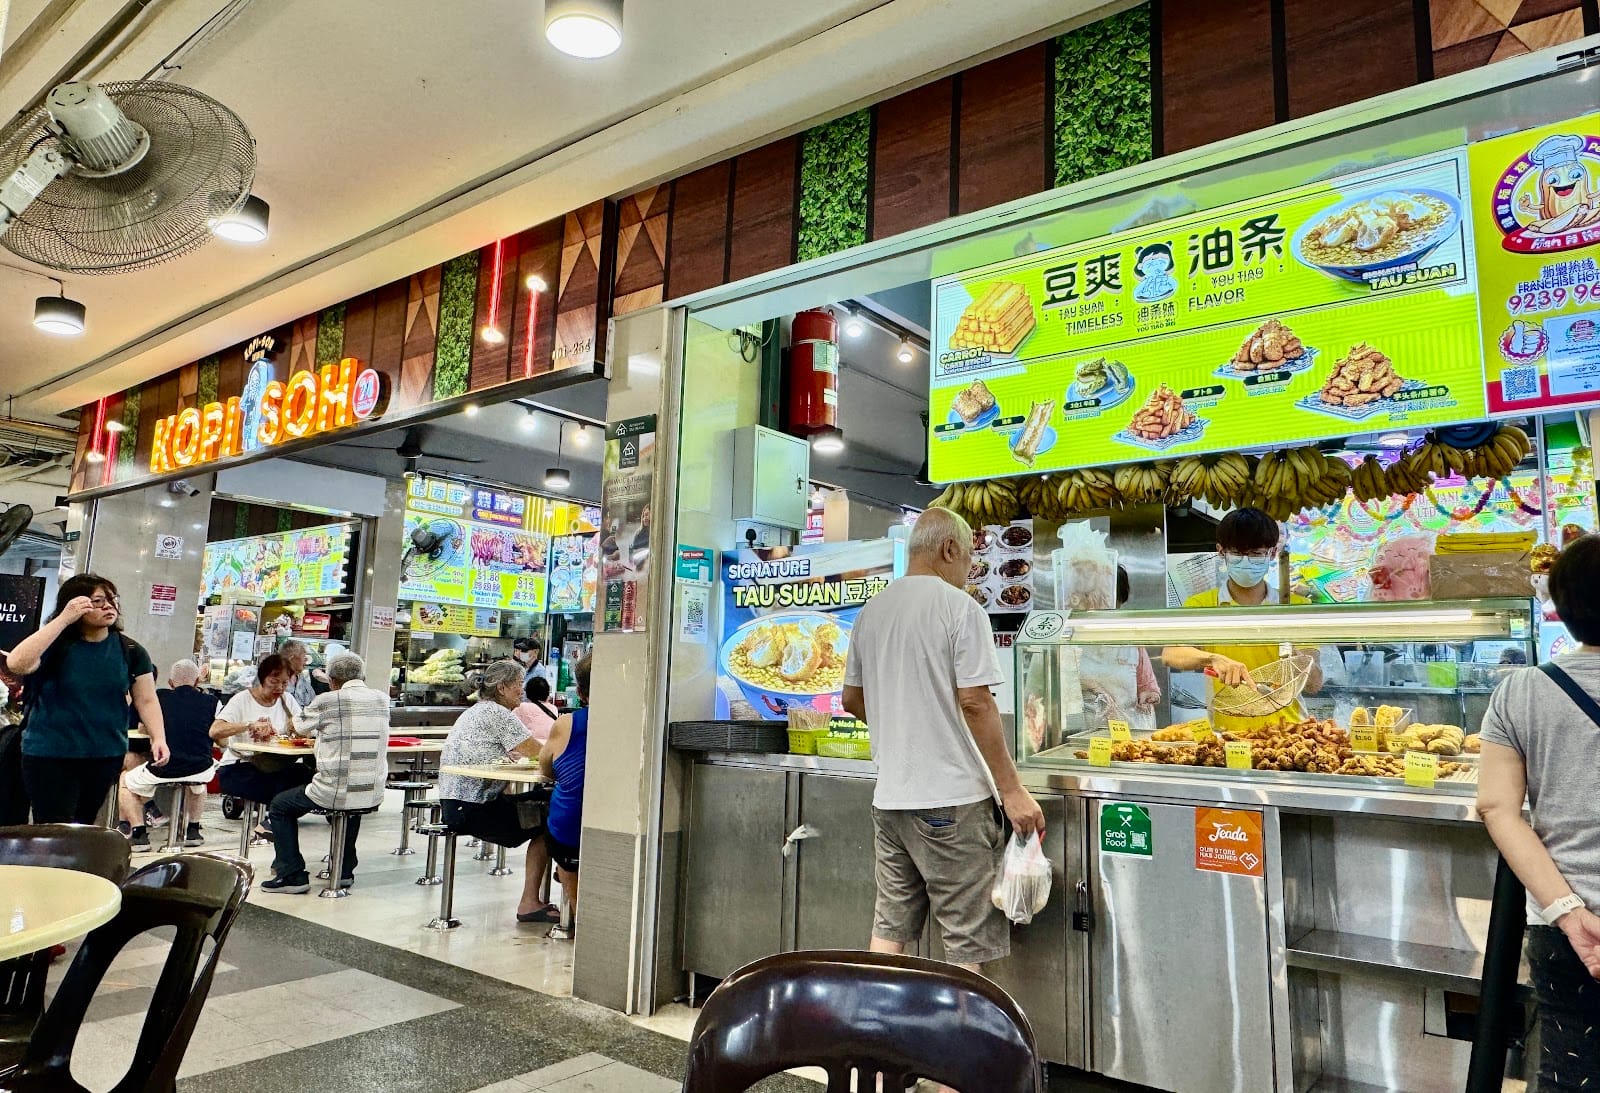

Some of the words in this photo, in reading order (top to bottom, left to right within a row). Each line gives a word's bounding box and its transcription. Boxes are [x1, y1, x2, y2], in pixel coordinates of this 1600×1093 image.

[1042, 252, 1123, 305] 豆爽
[1188, 213, 1287, 277] 油条
[1369, 272, 1403, 291] TAU
[1405, 263, 1456, 285] SUAN
[1518, 273, 1575, 294] FRANCHISE
[1188, 287, 1245, 311] FLAVOR
[1508, 288, 1567, 312] 9239
[1065, 312, 1123, 334] TIMELESS
[940, 346, 984, 364] CARROT
[150, 396, 242, 473] KOPI
[258, 358, 360, 444] SOH
[729, 559, 810, 579] SIGNATURE
[733, 584, 777, 608] TAU
[777, 582, 841, 606] SUAN
[1105, 829, 1126, 838] Grab
[1105, 838, 1126, 847] Food
[1214, 848, 1236, 856] STORE
[1214, 853, 1238, 862] JOINED
